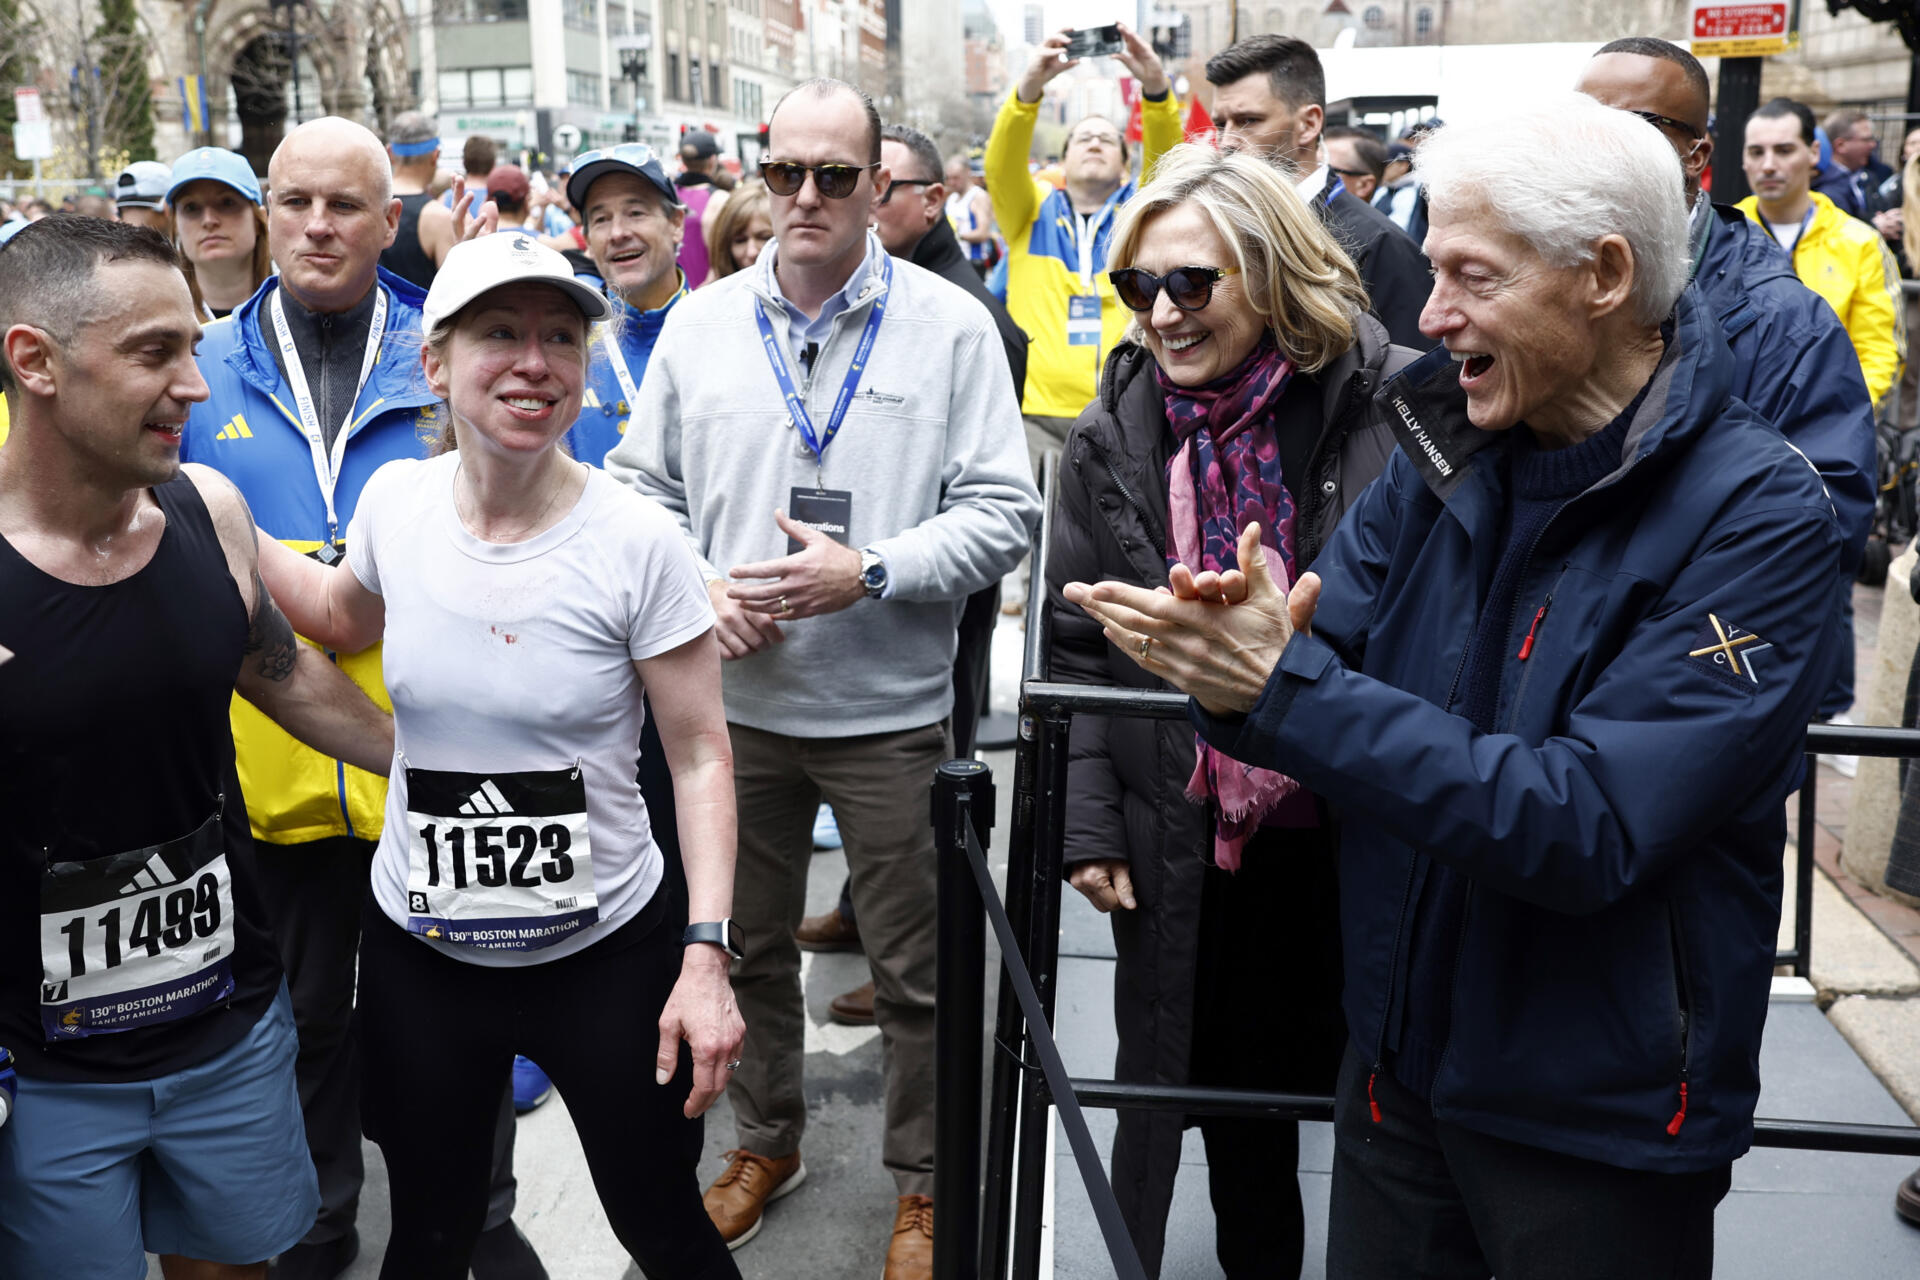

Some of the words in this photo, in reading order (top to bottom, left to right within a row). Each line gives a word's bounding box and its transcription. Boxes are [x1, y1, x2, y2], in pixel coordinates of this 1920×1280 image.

[1706, 9, 1721, 18] NO
[1723, 6, 1773, 17] STOPPING
[559, 132, 574, 147] T
[274, 307, 288, 337] FINISH
[371, 311, 384, 341] FINISH
[299, 396, 315, 427] FINISH
[1392, 396, 1421, 432] HELLY
[1415, 430, 1453, 477] HANSEN
[1727, 625, 1740, 639] Y
[1713, 651, 1726, 664] C
[419, 823, 575, 890] 11523
[411, 894, 426, 912] 8
[61, 872, 221, 979] 11499
[473, 930, 517, 941] BOSTON
[519, 919, 580, 939] MARATHON
[488, 941, 526, 949] AMERICA
[47, 984, 62, 1001] 7
[117, 995, 163, 1014] BOSTON
[166, 973, 218, 1002] MARATHON
[119, 1014, 131, 1022] OF
[132, 1004, 172, 1019] AMERICA
